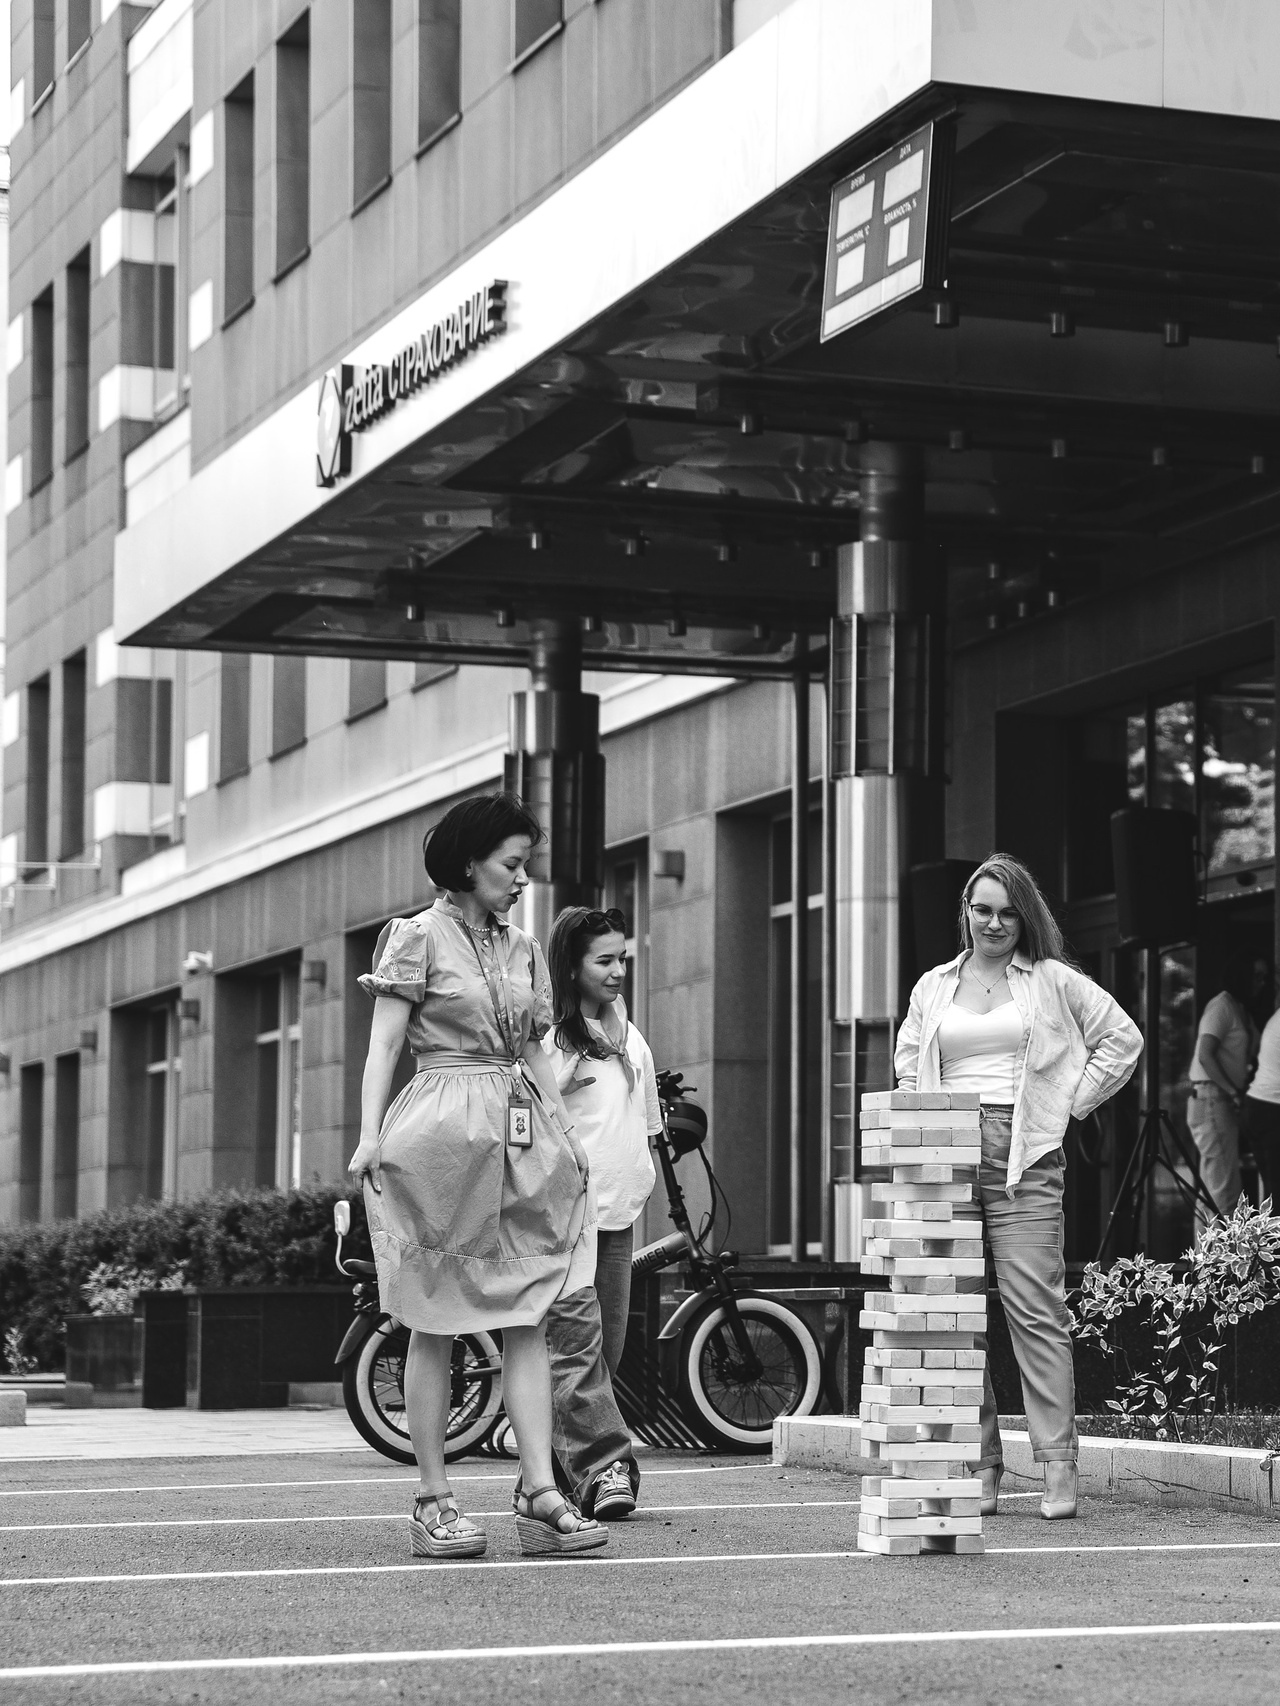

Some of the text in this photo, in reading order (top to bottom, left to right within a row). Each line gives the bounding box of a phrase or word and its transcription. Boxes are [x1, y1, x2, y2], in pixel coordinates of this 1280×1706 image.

[899, 143, 911, 160] ДАТА
[851, 173, 866, 190] ВРЕМЯ
[344, 279, 504, 433] zetta СТРАХОВАНИЕ
